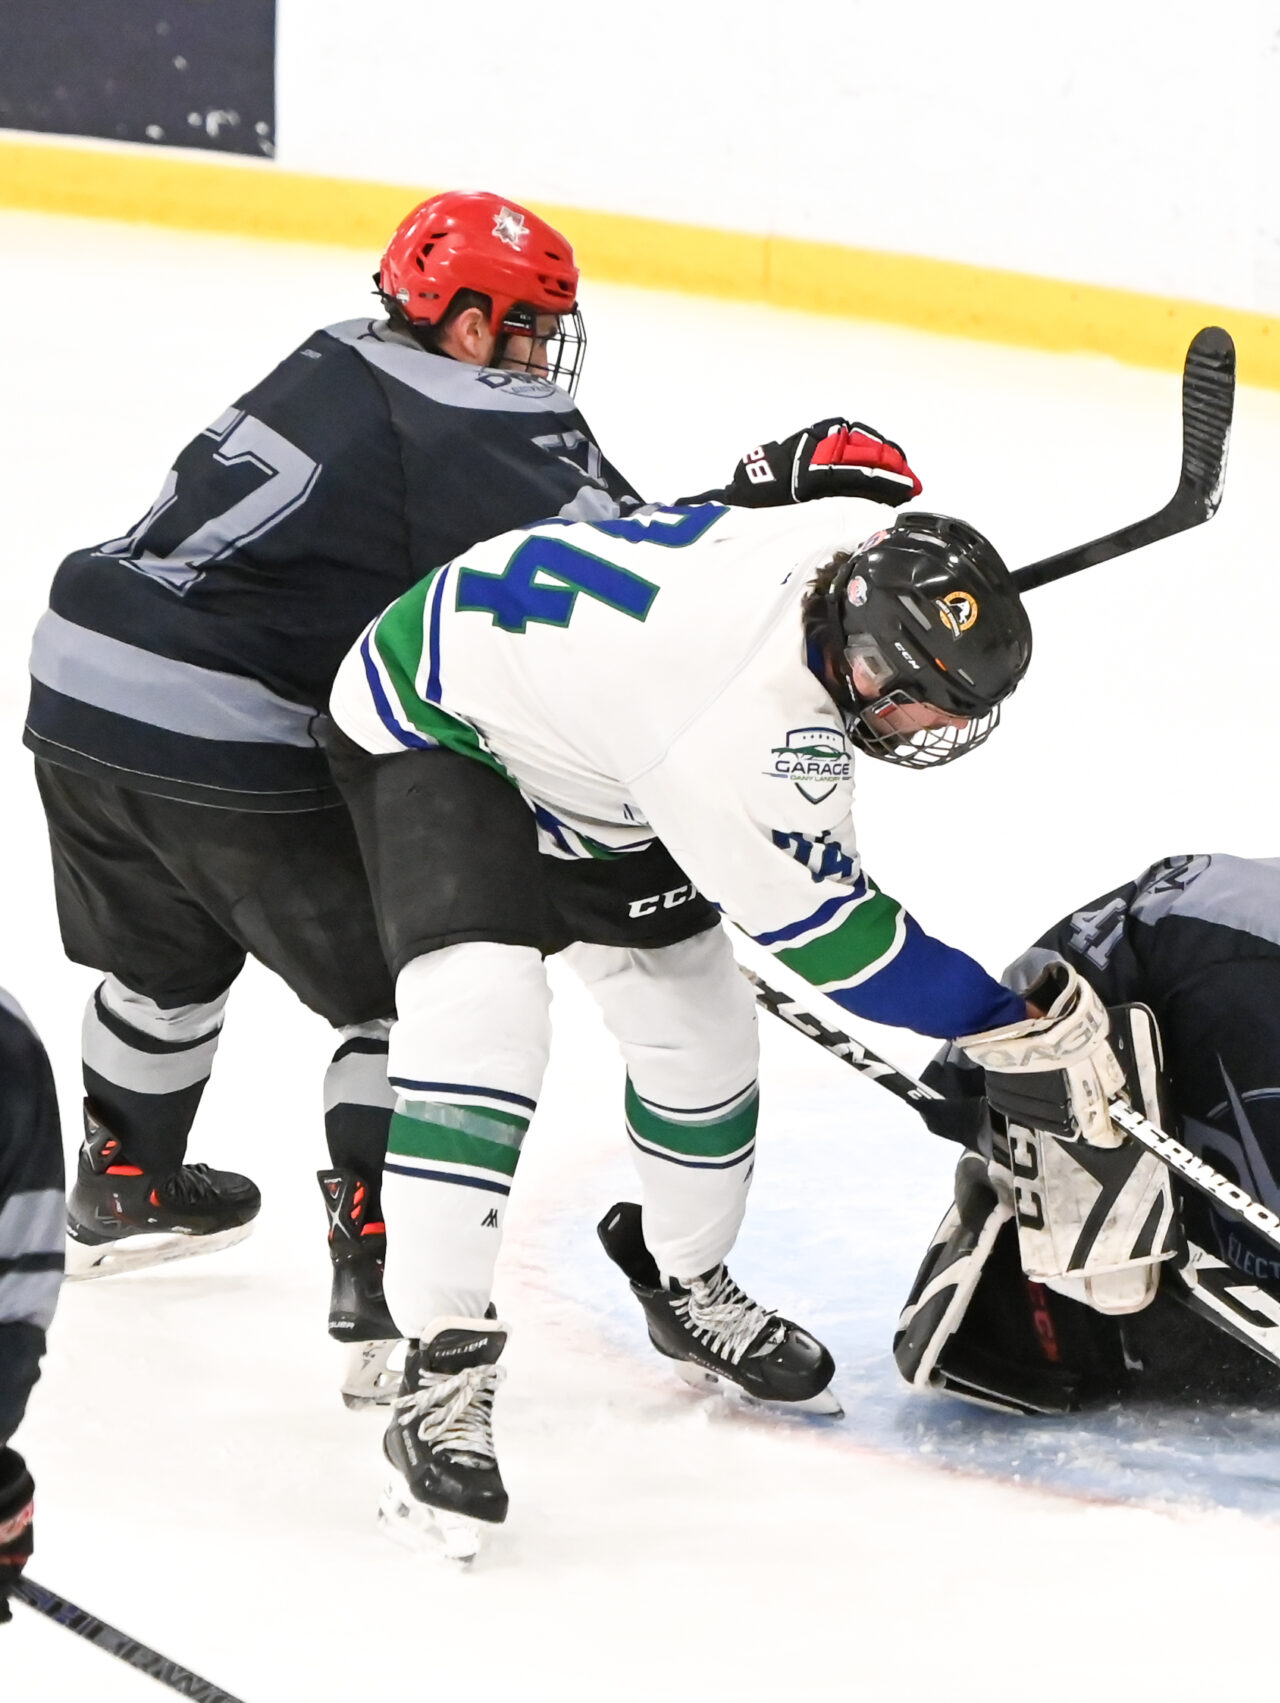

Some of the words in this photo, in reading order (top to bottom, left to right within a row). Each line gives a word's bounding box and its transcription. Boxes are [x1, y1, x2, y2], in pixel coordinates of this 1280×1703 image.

[775, 760, 850, 776] GARAGE
[1068, 897, 1127, 971] 41
[1010, 1132, 1046, 1232] CC
